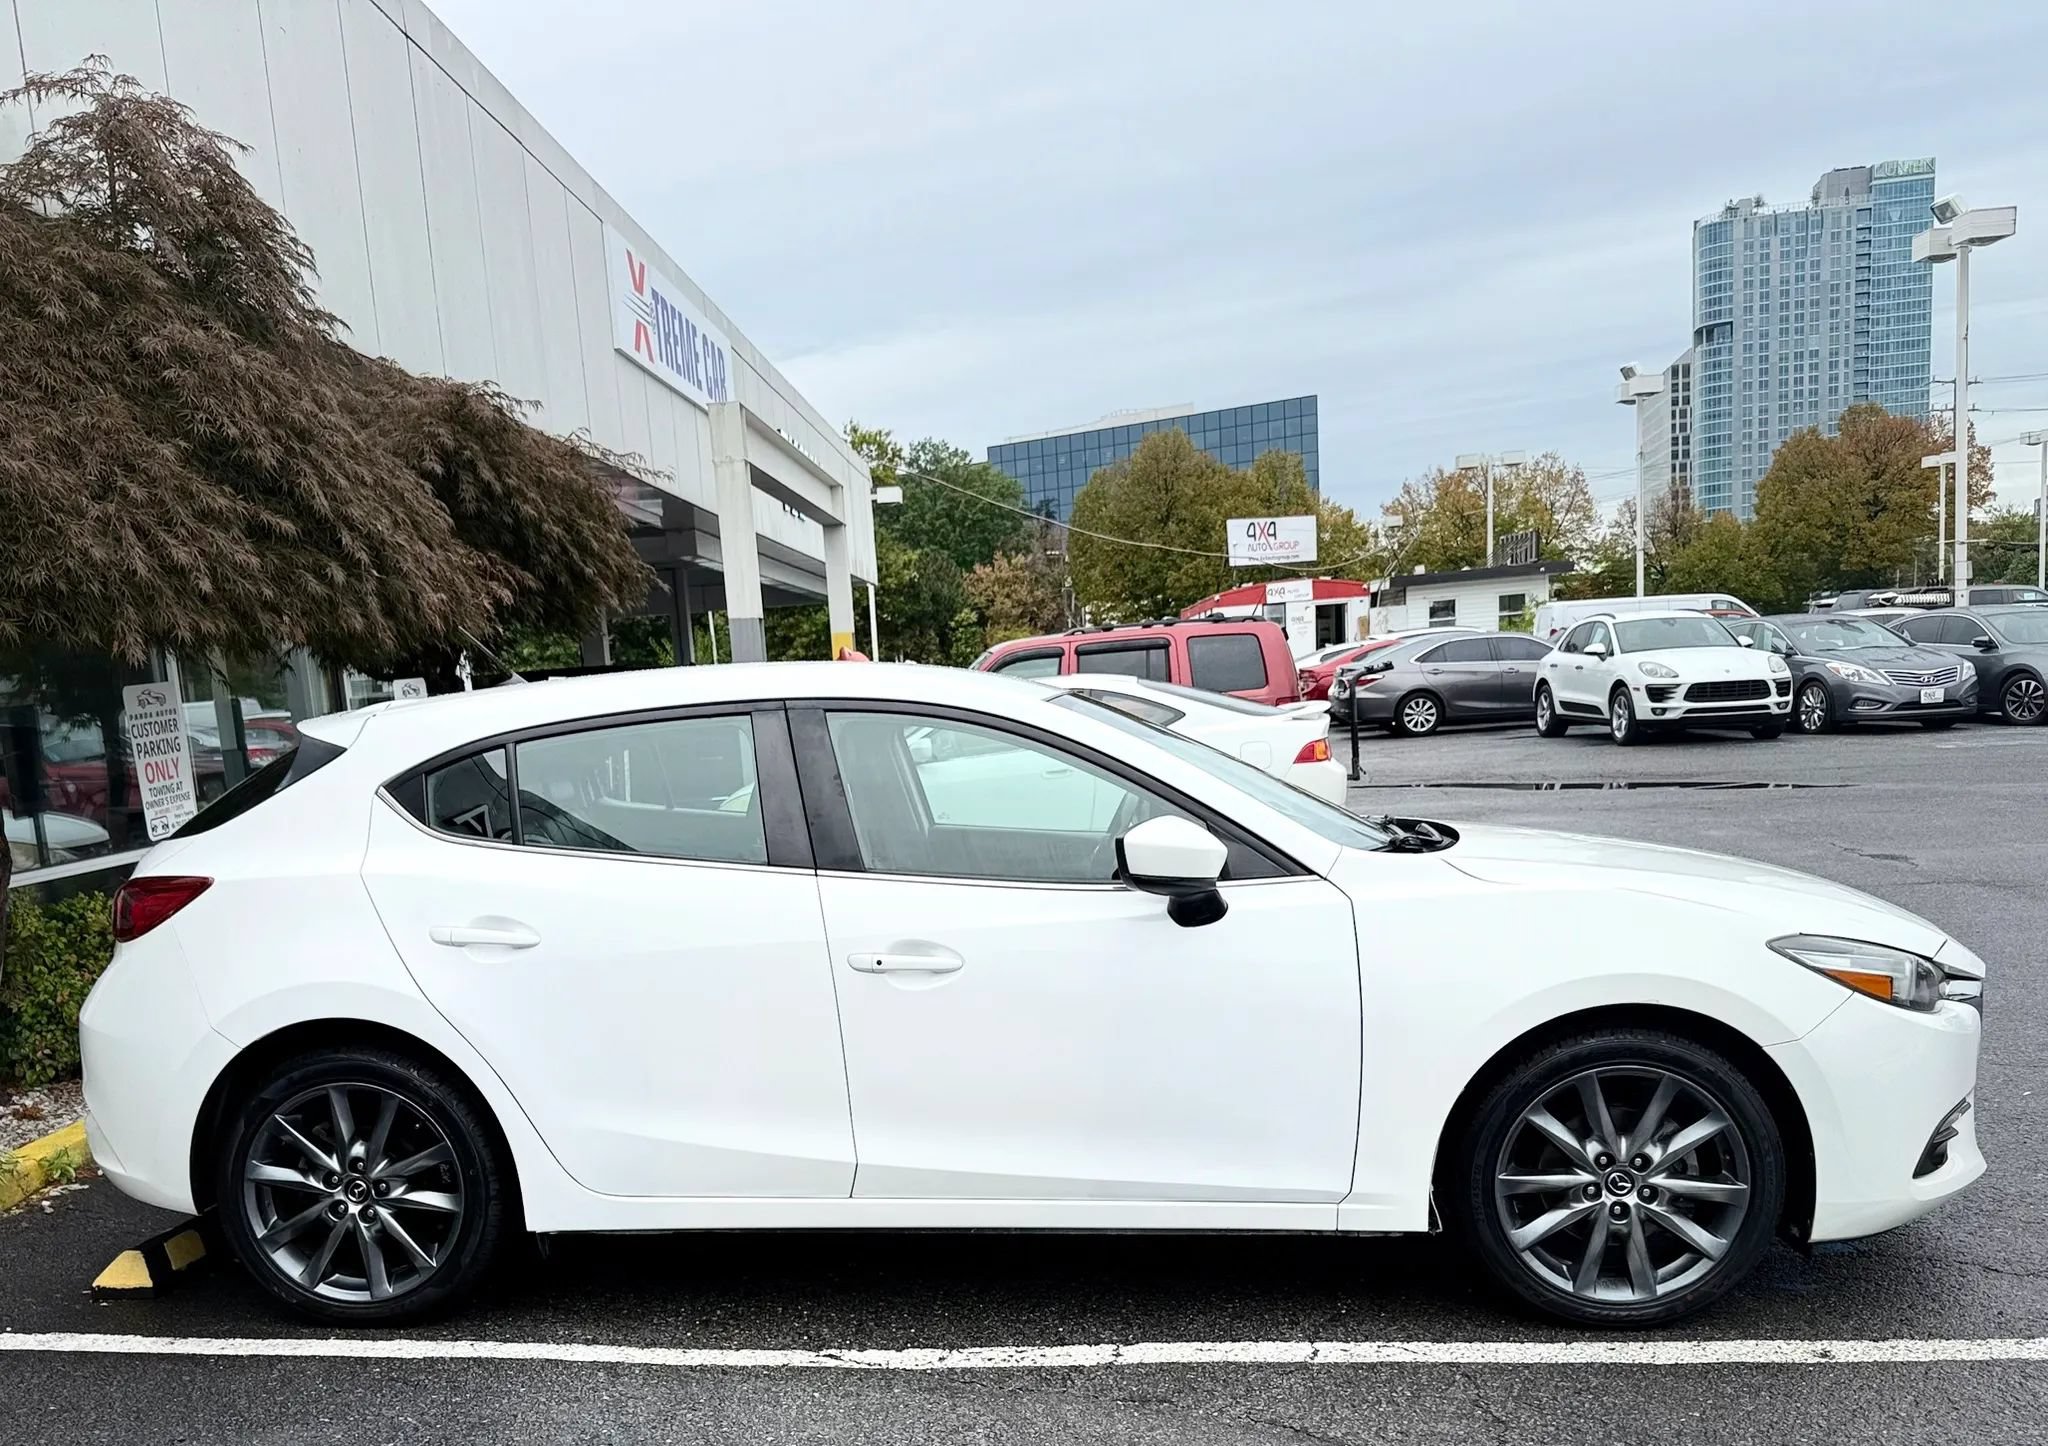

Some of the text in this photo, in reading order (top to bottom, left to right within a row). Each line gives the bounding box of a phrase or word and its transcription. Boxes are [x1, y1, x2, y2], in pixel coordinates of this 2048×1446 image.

[702, 333, 728, 403] CAR
[1247, 540, 1300, 552] AUTO GROUP
[131, 718, 179, 739] CUSTOMER
[136, 736, 181, 760] PARKING
[144, 757, 181, 785] ONLY
[149, 781, 183, 798] TOWING AT
[170, 791, 191, 805] EXPENSE
